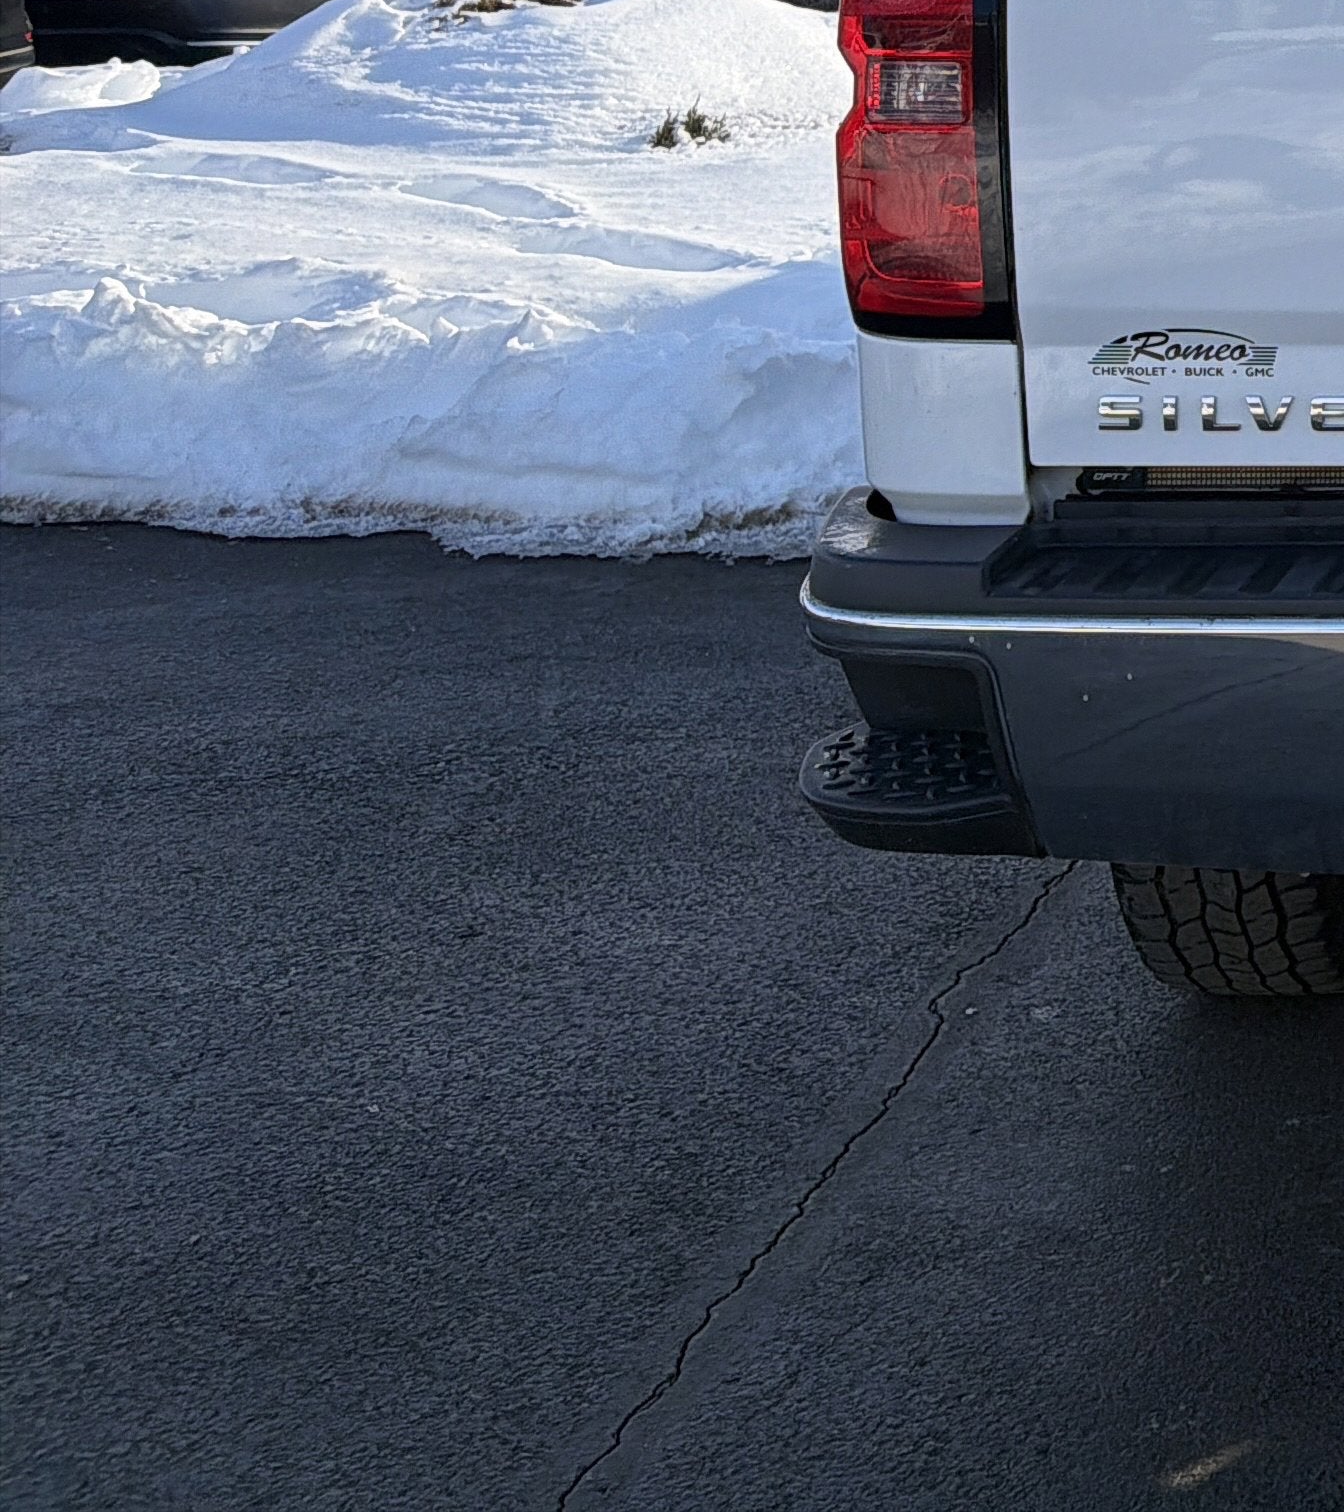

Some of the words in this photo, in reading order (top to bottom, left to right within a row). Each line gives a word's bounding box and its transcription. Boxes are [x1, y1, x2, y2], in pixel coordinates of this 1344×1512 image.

[1130, 331, 1250, 362] Romeo
[1092, 366, 1168, 377] CHEVROLET
[1184, 367, 1225, 377] BUICK
[1245, 367, 1275, 377] GMC
